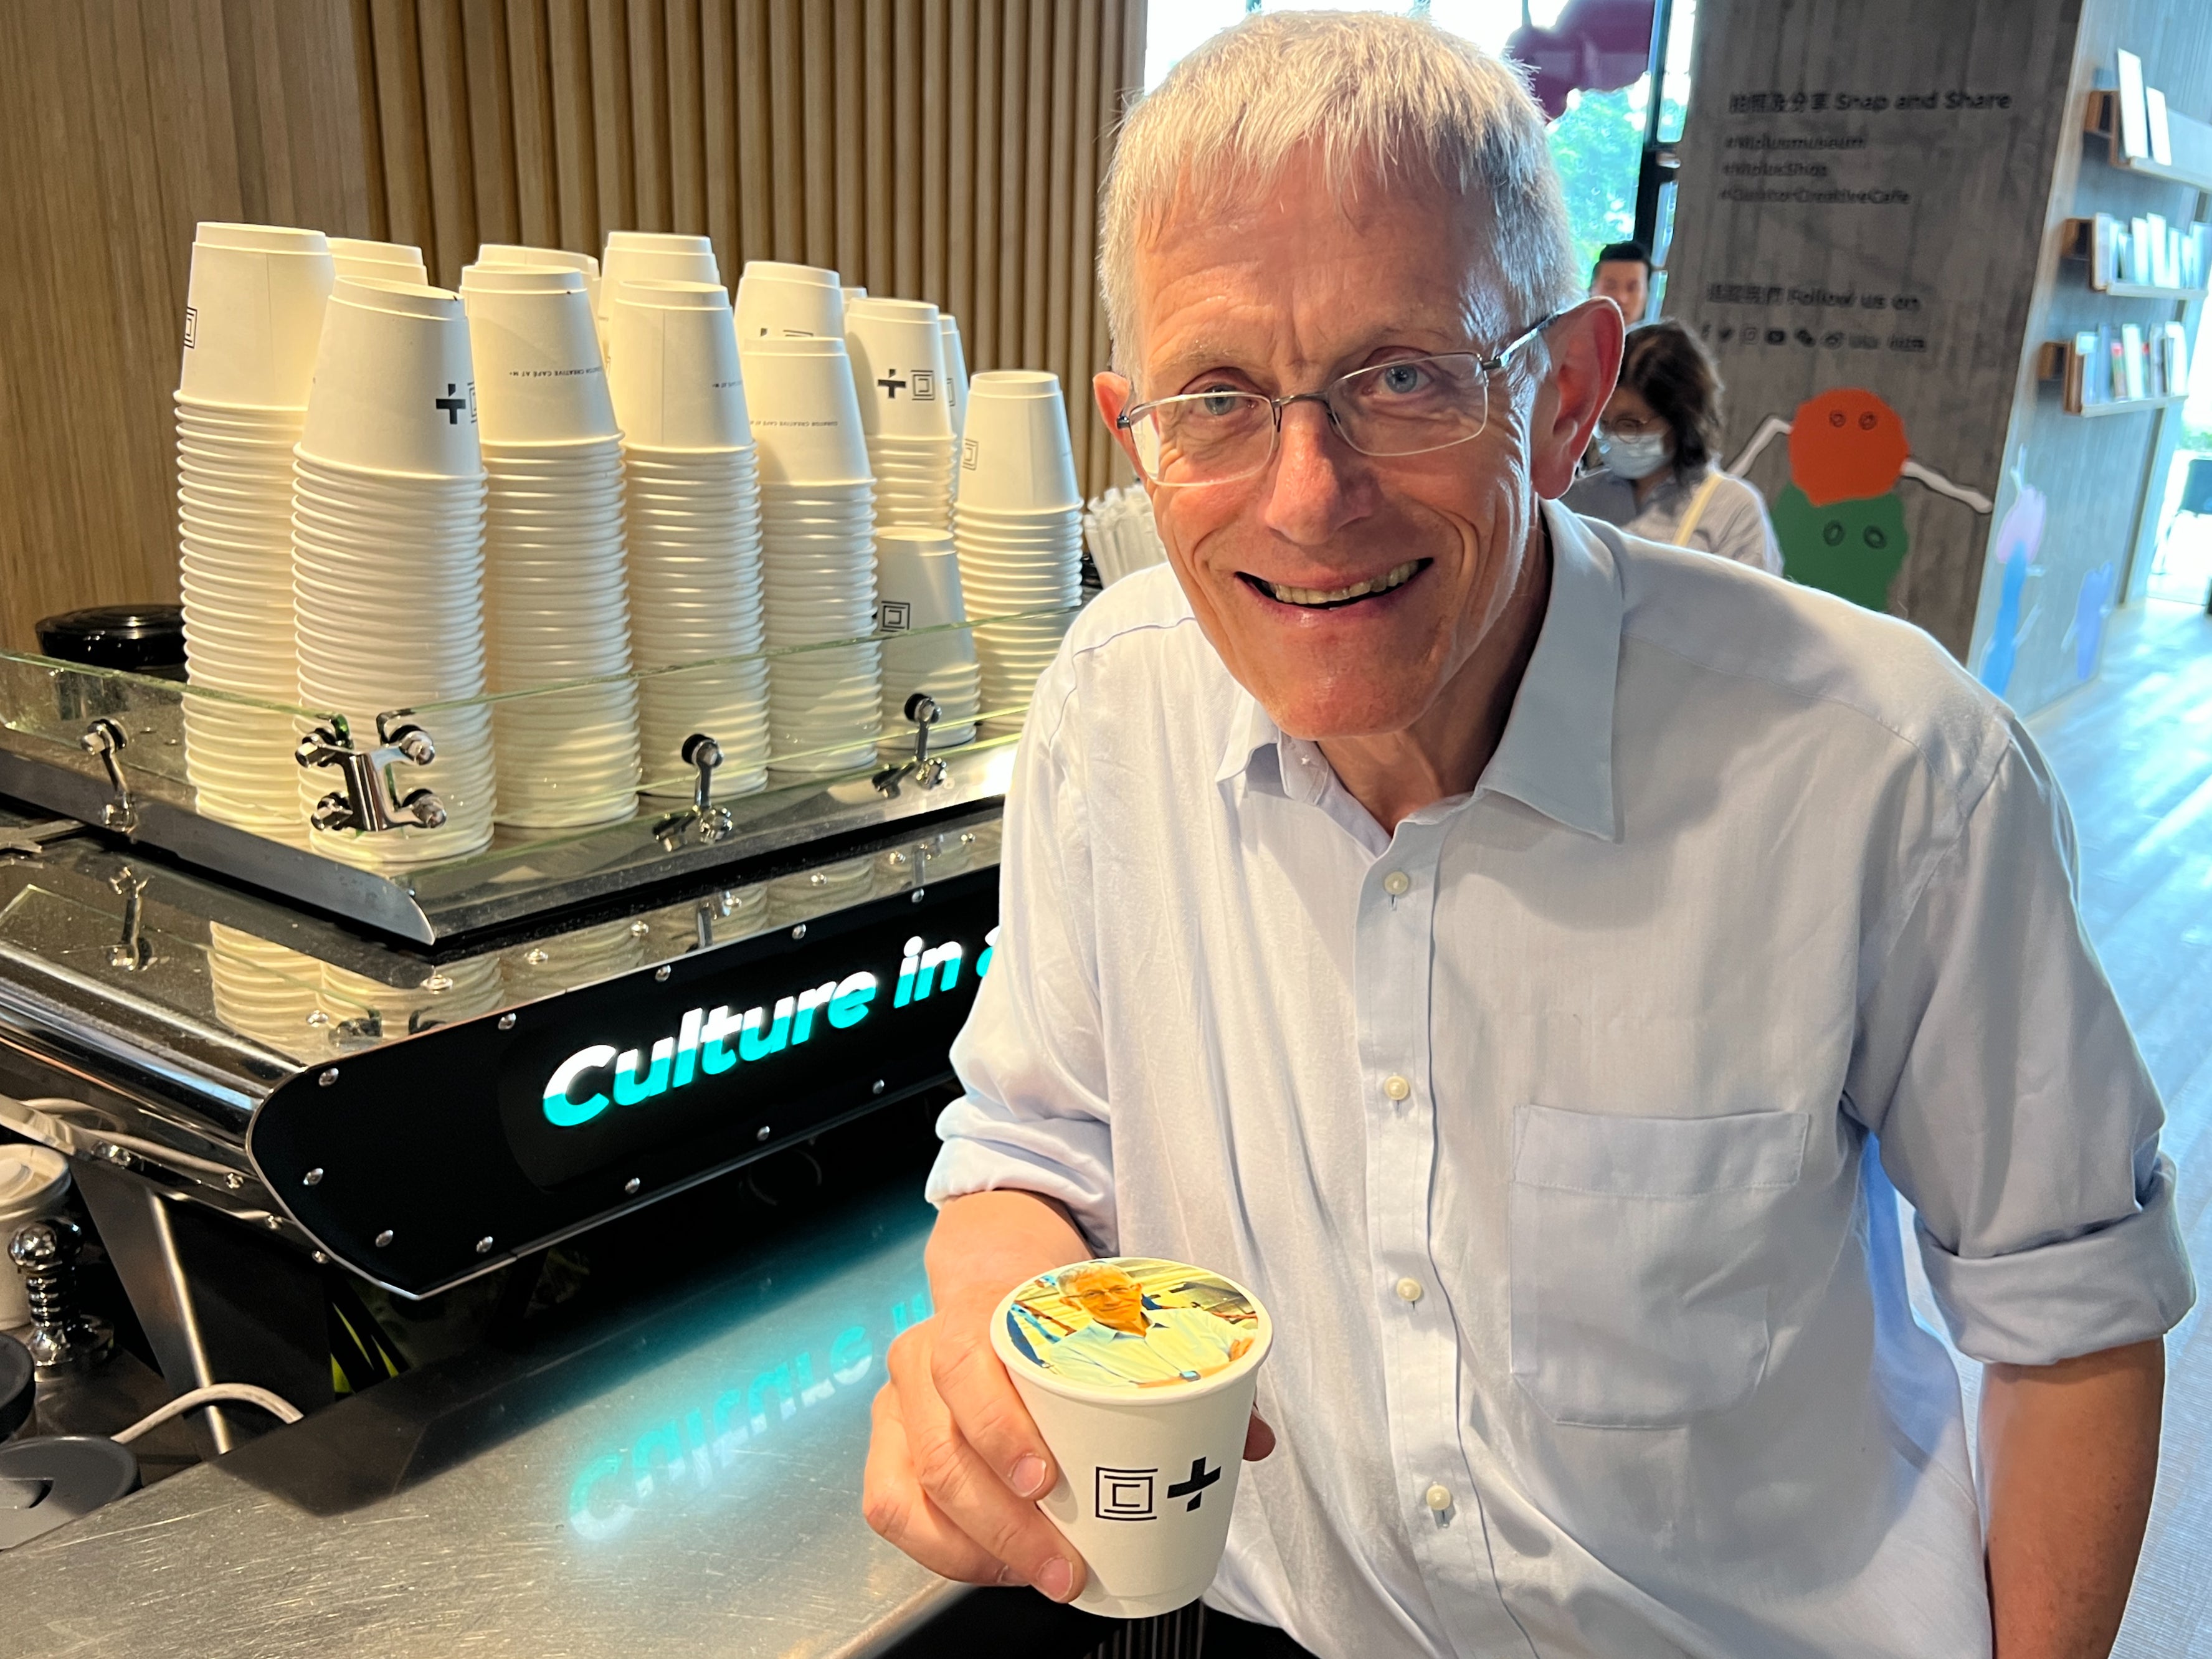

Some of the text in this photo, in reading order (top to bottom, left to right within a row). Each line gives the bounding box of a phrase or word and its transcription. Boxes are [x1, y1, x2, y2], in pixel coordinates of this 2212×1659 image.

[1835, 92, 1889, 113] Snap
[1894, 91, 1939, 110] and
[1944, 92, 2013, 110] Share
[543, 971, 877, 1126] Culture
[893, 936, 962, 1009] in
